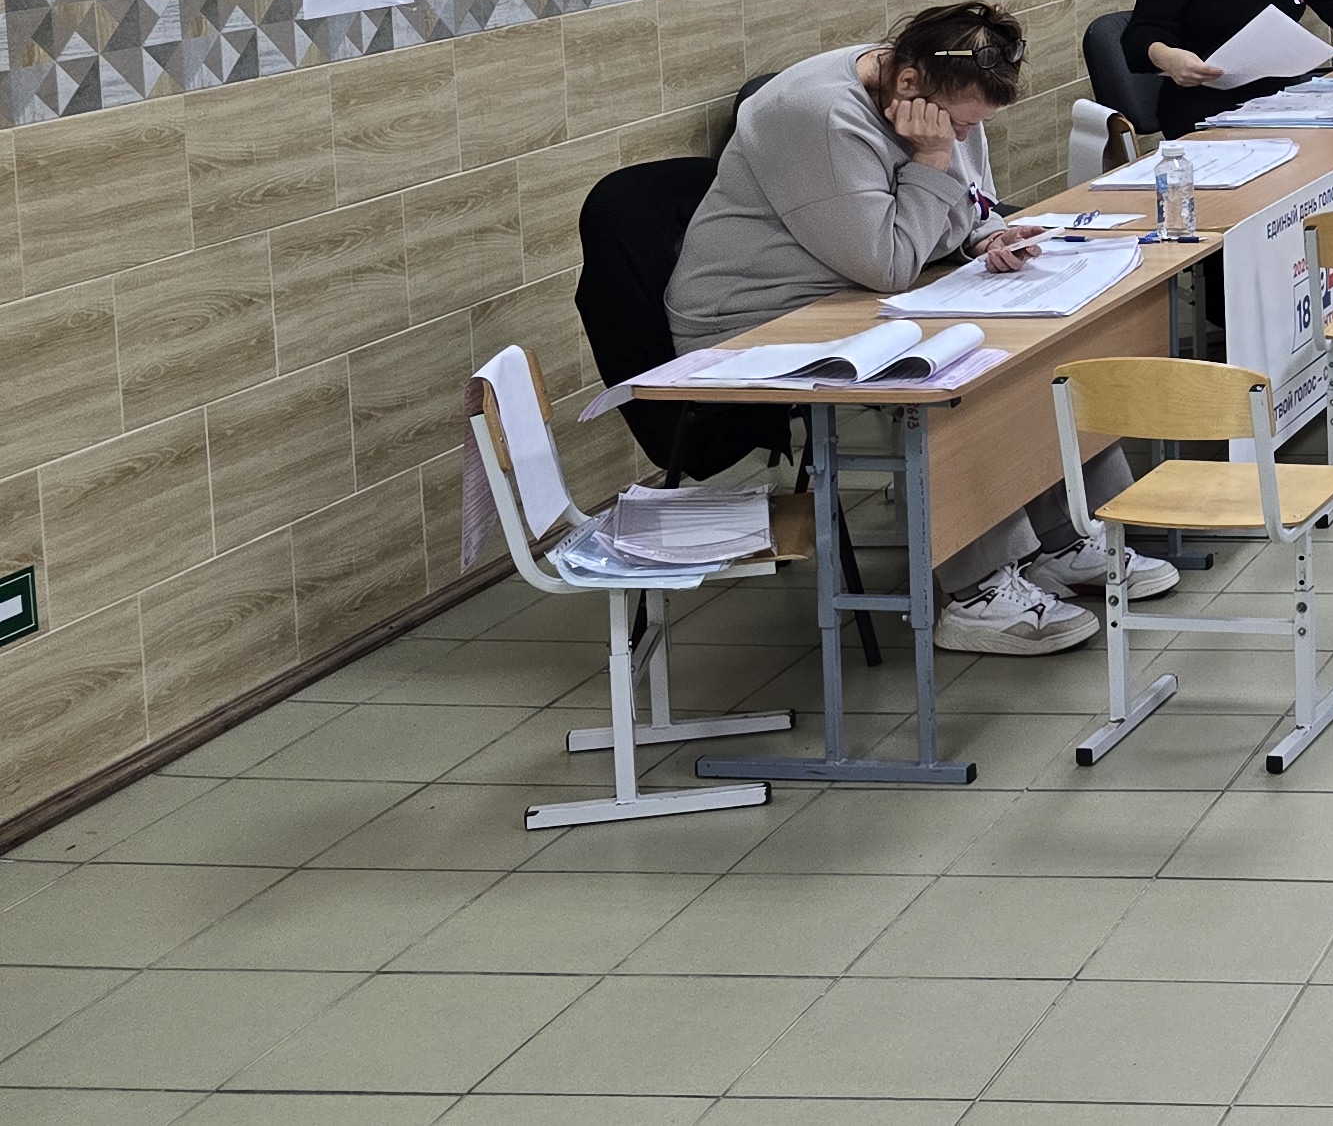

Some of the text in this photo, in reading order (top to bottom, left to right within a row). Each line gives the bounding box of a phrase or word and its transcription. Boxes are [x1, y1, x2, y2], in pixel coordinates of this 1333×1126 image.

[1266, 203, 1299, 240] ЕДИНЫЙ
[1299, 197, 1318, 223] ДЕНЬ
[1297, 294, 1311, 333] 18
[1273, 390, 1293, 422] ТВОЙ
[1293, 375, 1317, 407] ГОЛОС
